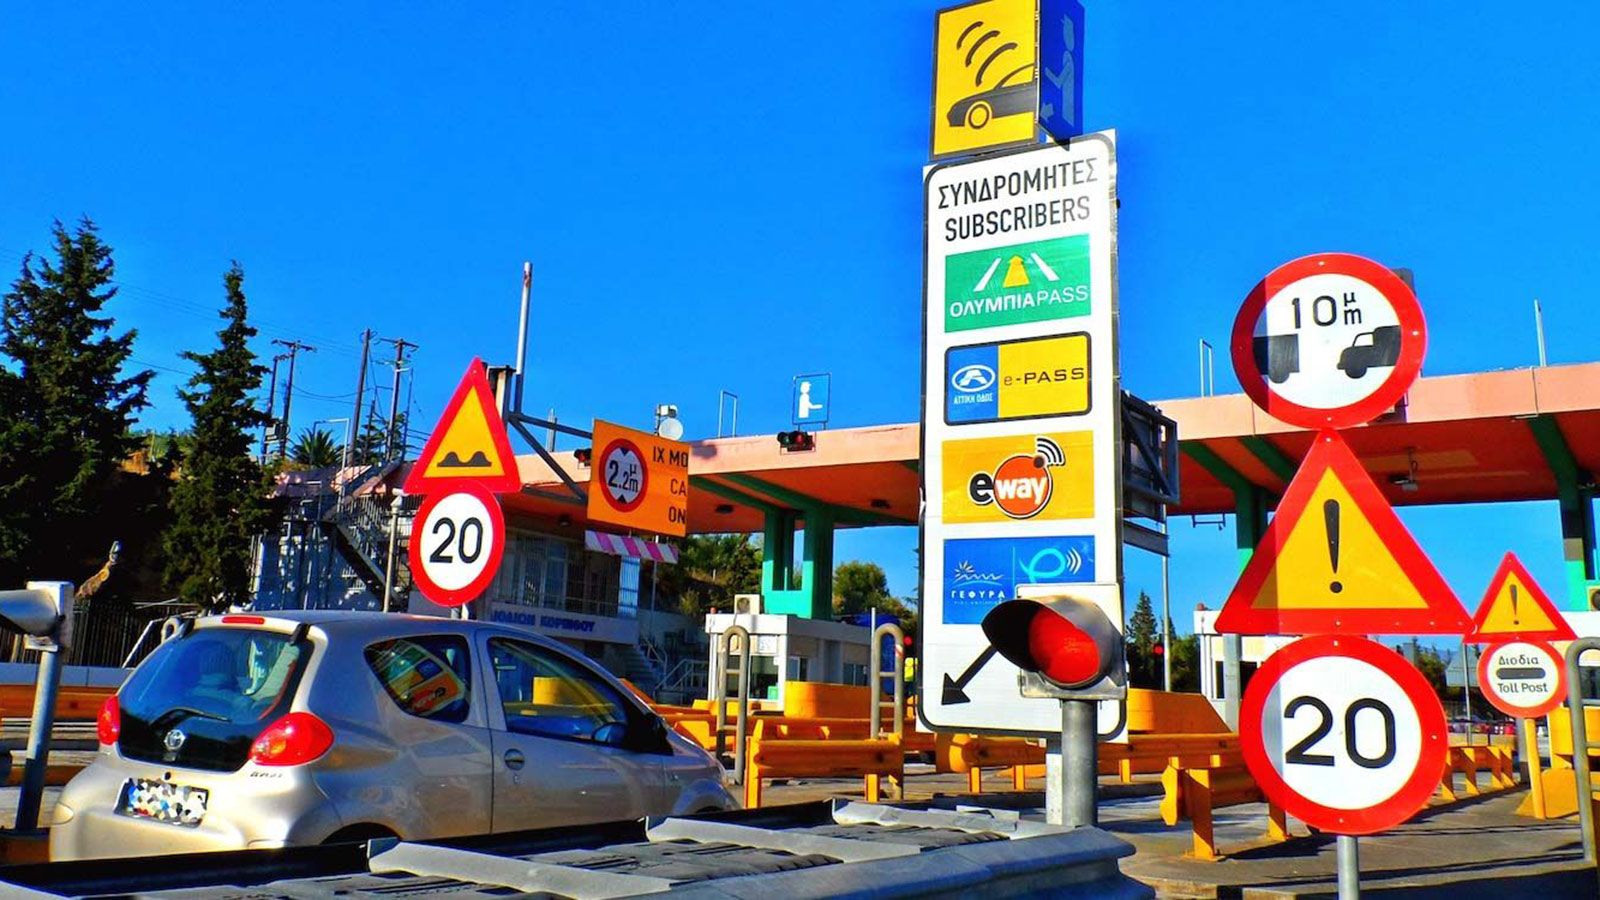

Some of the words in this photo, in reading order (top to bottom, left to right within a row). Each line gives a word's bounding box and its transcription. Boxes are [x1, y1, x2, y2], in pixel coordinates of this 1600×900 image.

[938, 157, 1098, 209] ΣΥΝΔΡΟΜΗΤΕΣ
[945, 195, 1091, 242] SUBSCRIBERS
[1292, 295, 1337, 329] 10
[1003, 367, 1085, 386] e-PASS
[969, 473, 1048, 506] eway
[429, 517, 483, 564] 20
[1497, 683, 1518, 693] Toll
[1521, 683, 1548, 693] Post
[1284, 695, 1397, 769] 20
